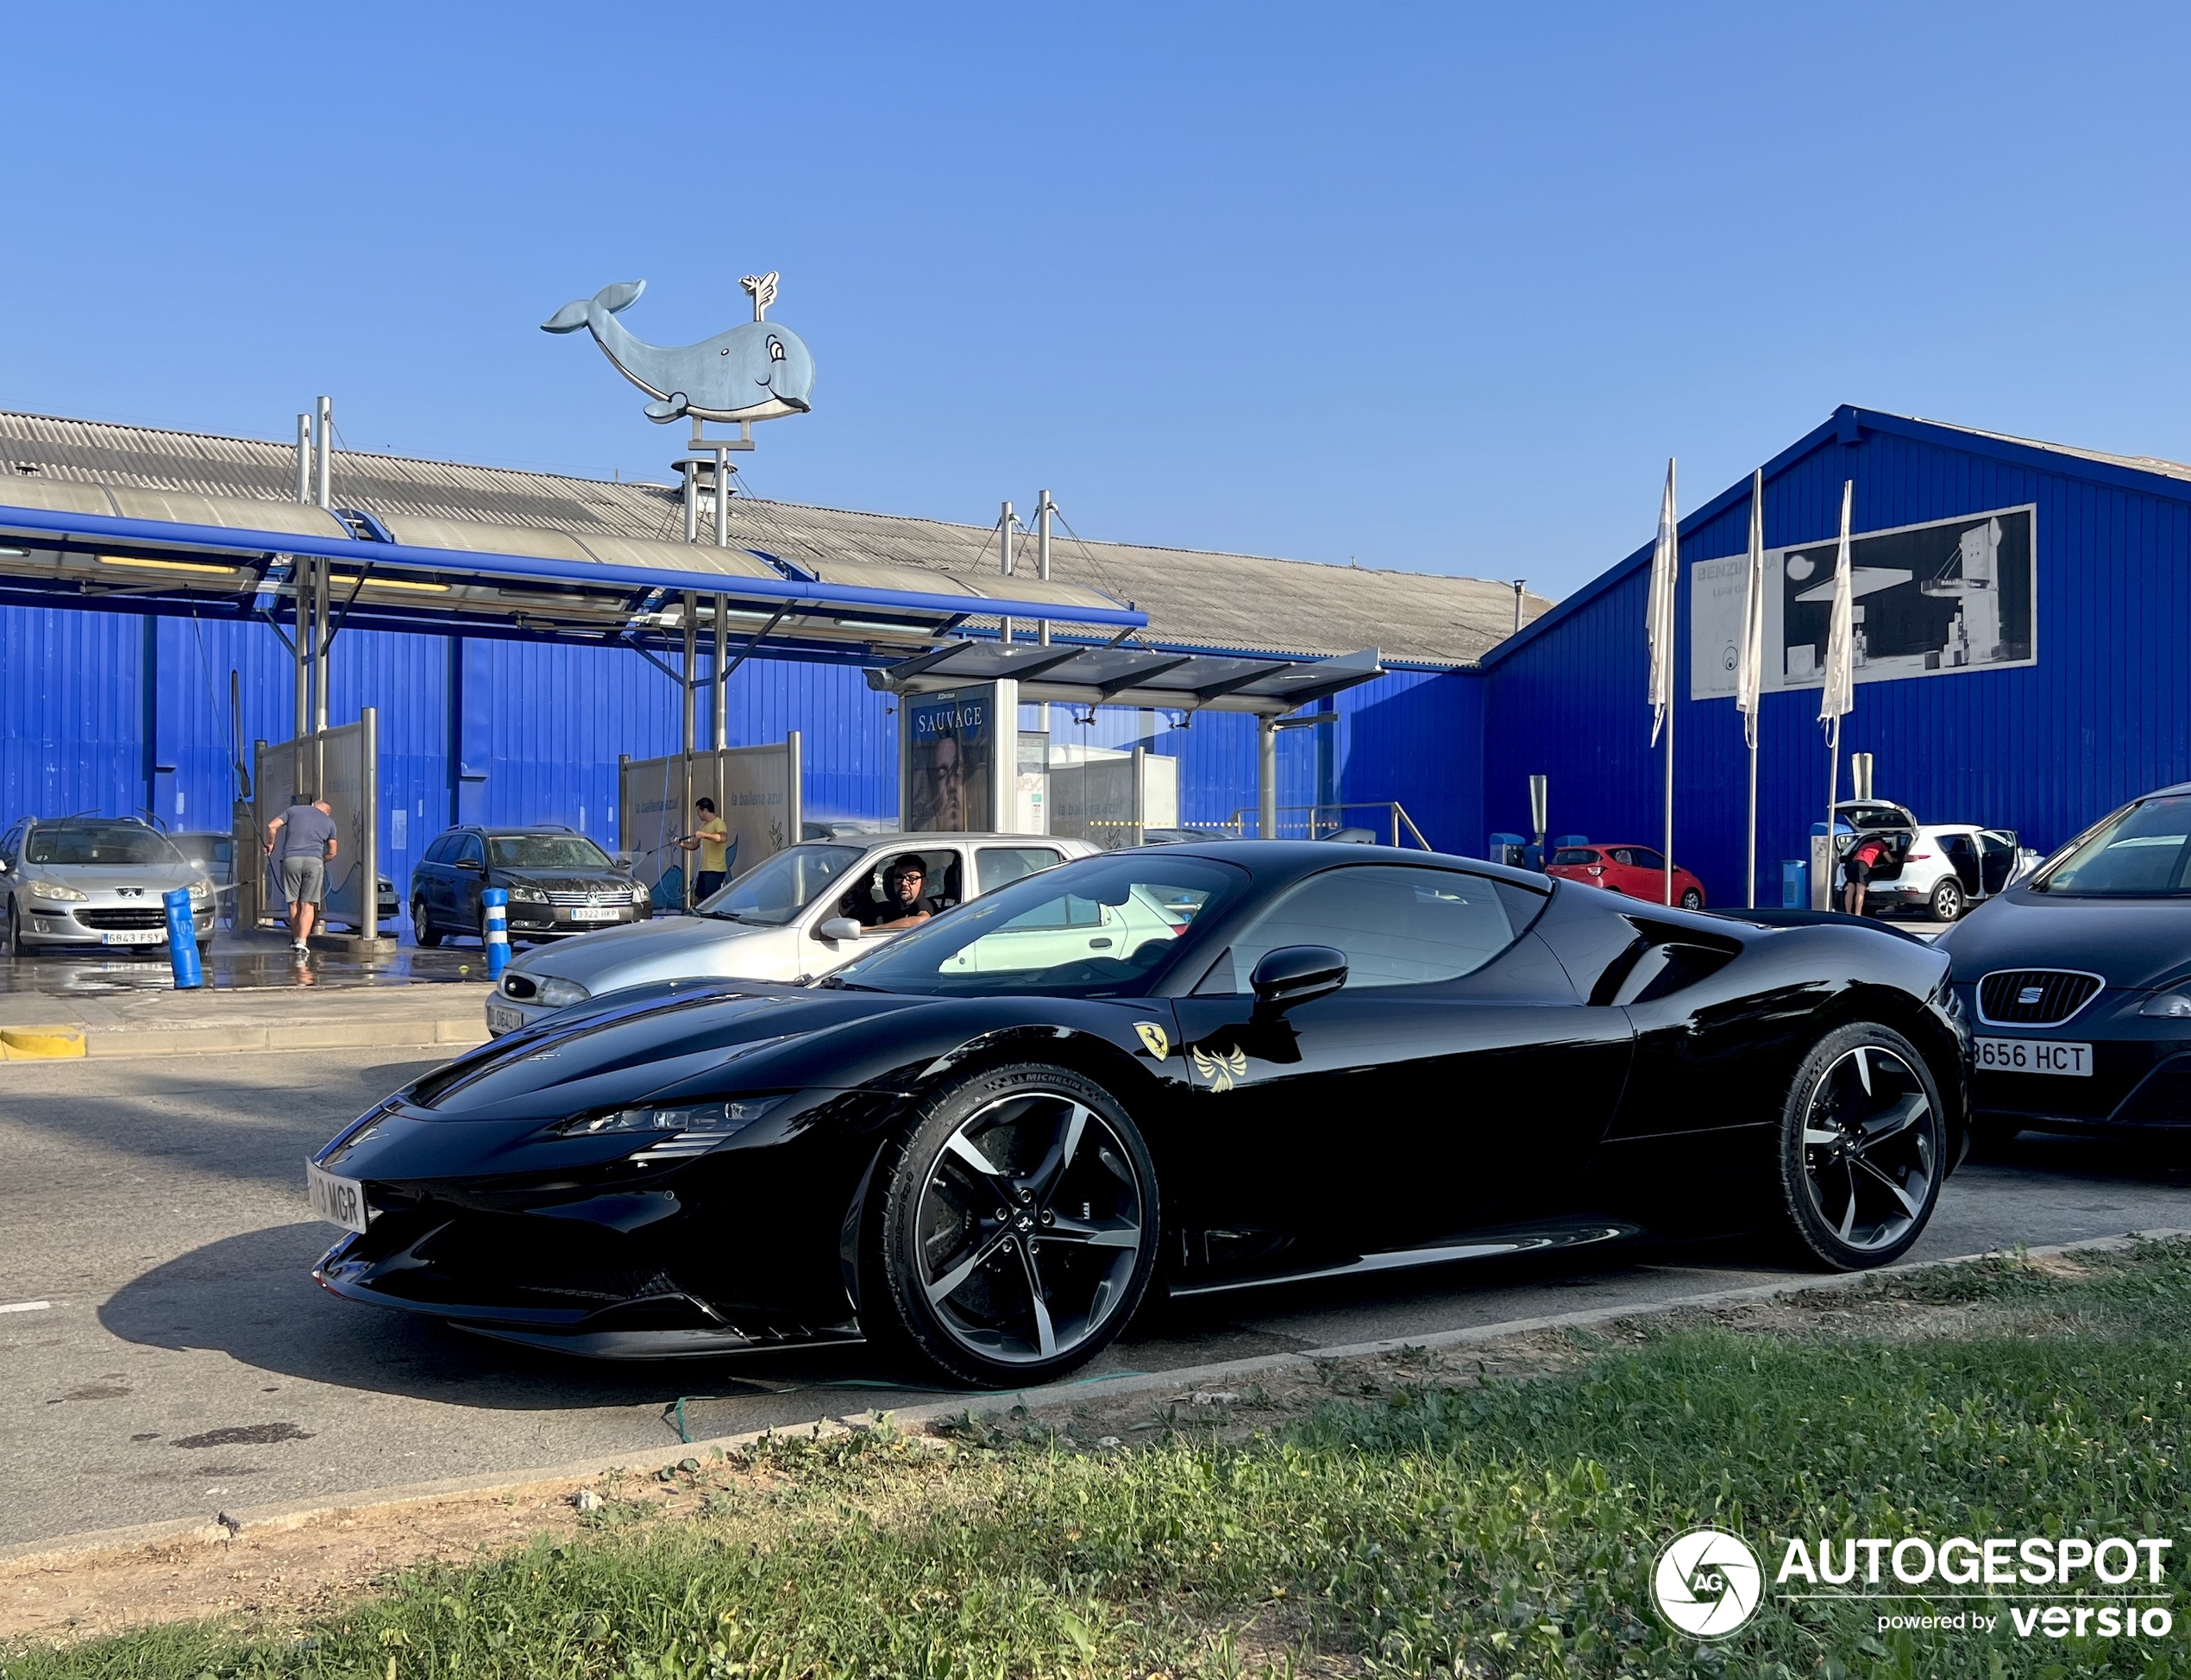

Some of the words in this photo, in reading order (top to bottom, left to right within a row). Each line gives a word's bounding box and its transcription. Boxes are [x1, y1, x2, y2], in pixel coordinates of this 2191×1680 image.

[919, 706, 982, 733] SAUVAGE
[731, 791, 738, 806] la
[738, 789, 766, 806] ballena
[767, 789, 783, 806] azul
[578, 910, 599, 918] 3322
[600, 909, 617, 918] HKP
[109, 933, 135, 943] 6843
[140, 933, 160, 943] FSY
[2036, 1045, 2085, 1071] HCT
[1026, 1073, 1082, 1089] MICHELIN
[328, 1182, 359, 1226] MGR
